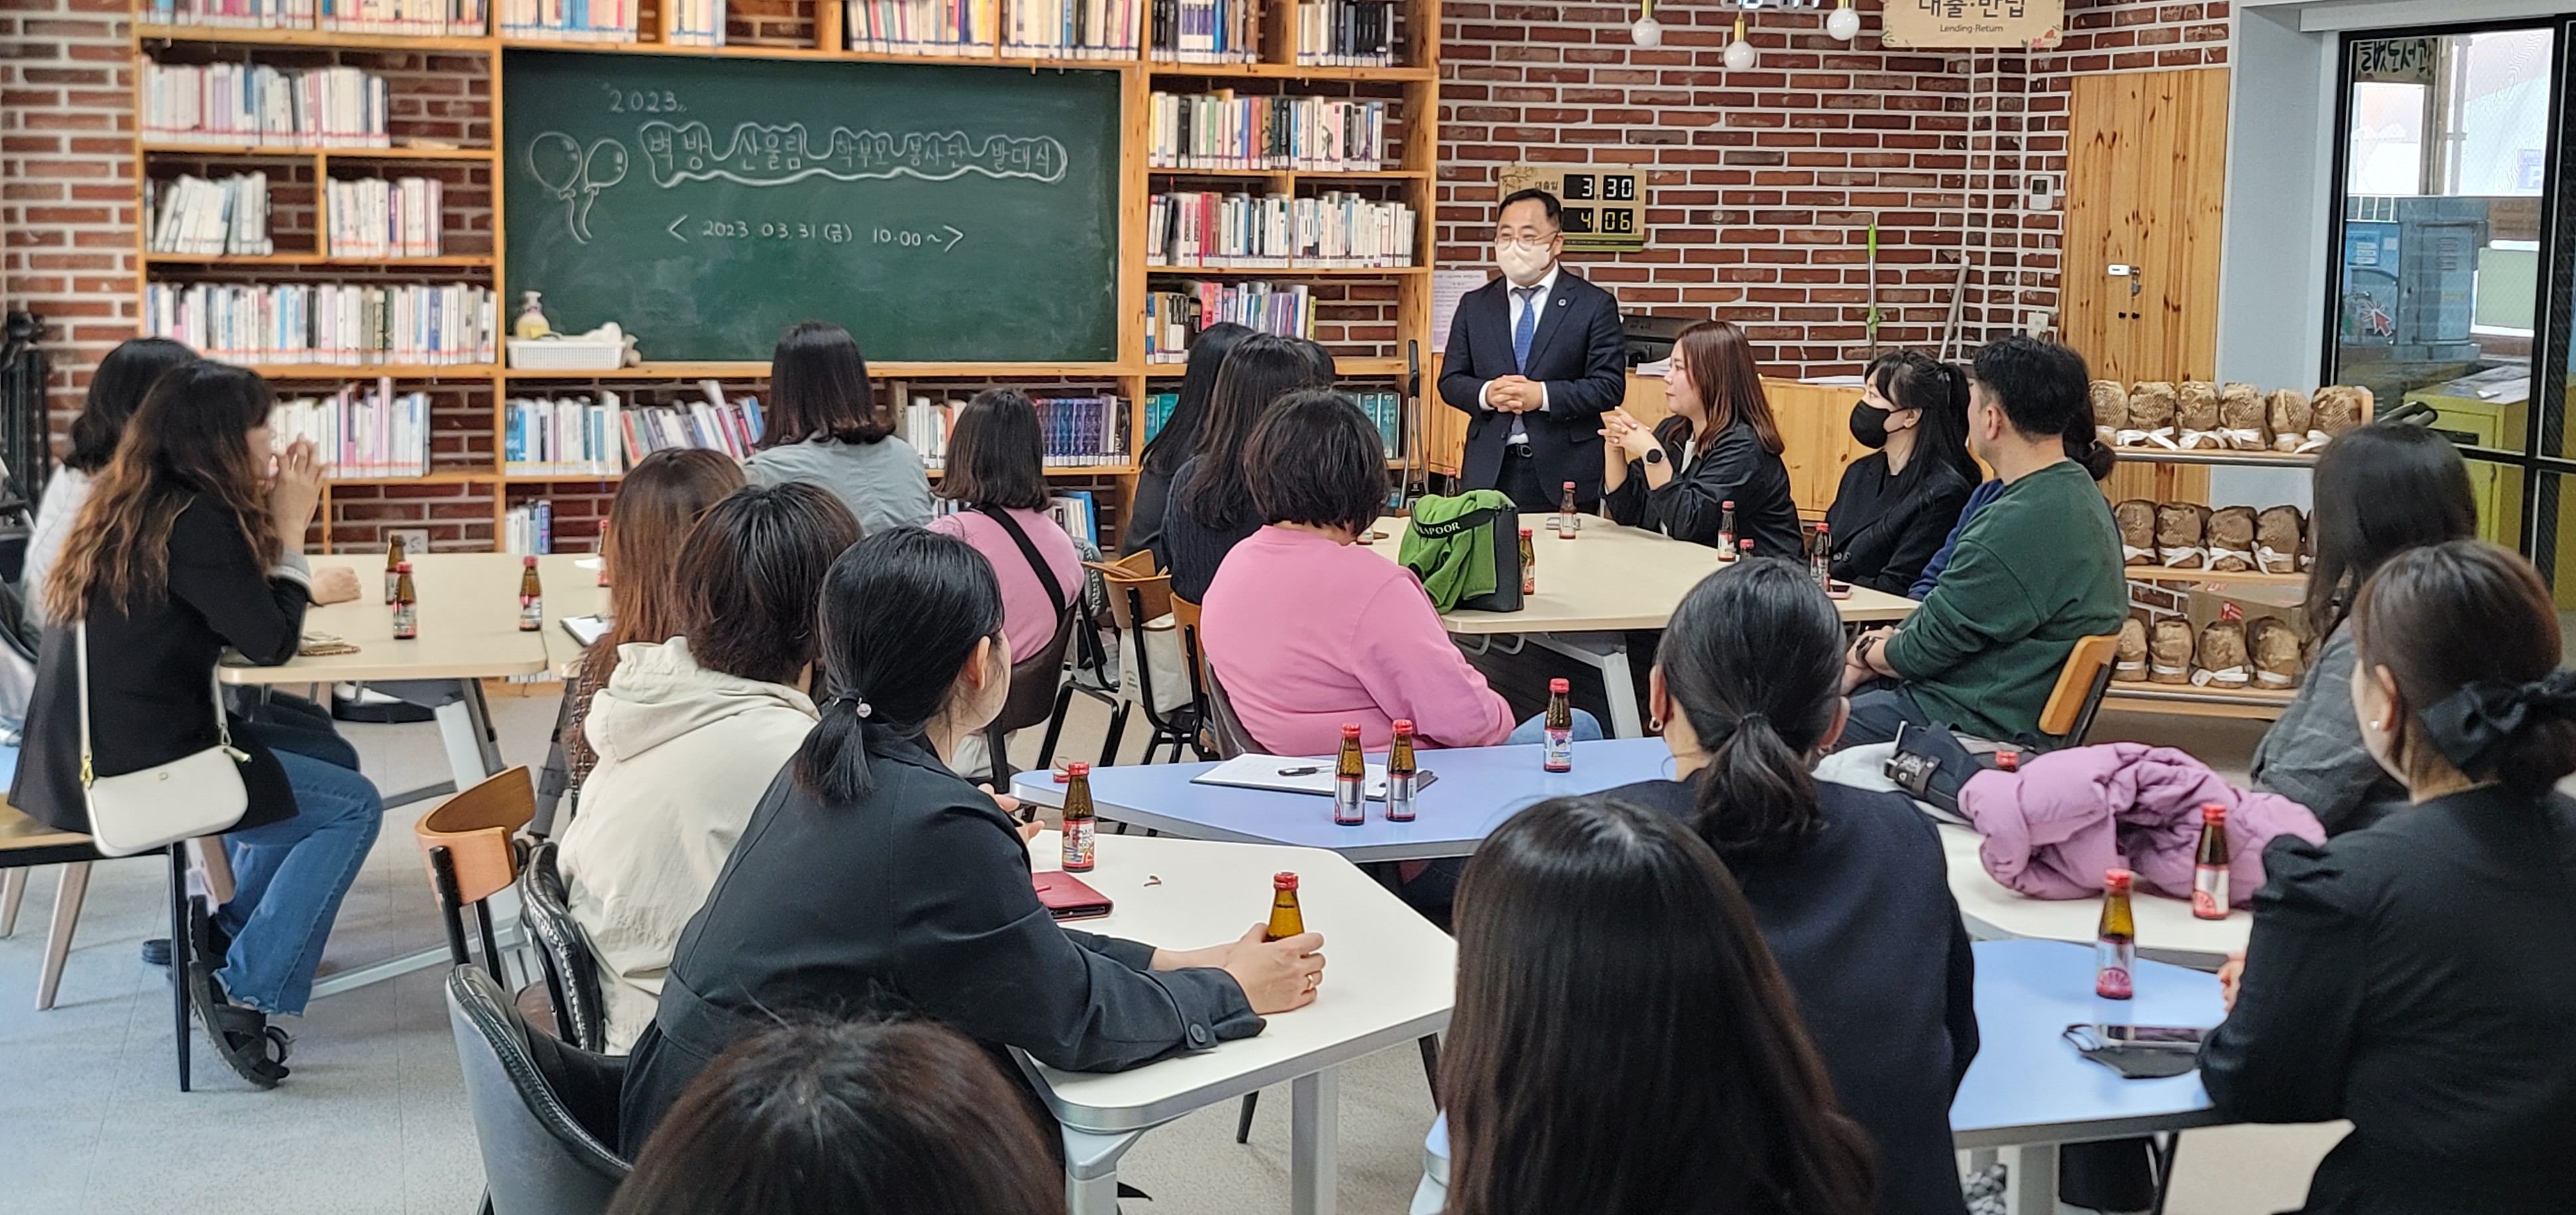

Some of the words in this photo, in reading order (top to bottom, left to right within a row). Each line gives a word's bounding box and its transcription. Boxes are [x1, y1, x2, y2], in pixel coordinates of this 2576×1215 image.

[738, 129, 804, 171] 산울림
[835, 133, 889, 168] 학부모
[908, 138, 966, 169] 봉사단
[991, 141, 1052, 176] 발대식
[1582, 177, 1593, 197] 3
[1606, 178, 1632, 198] 30
[1581, 211, 1592, 229] 4
[1604, 211, 1630, 230] 06
